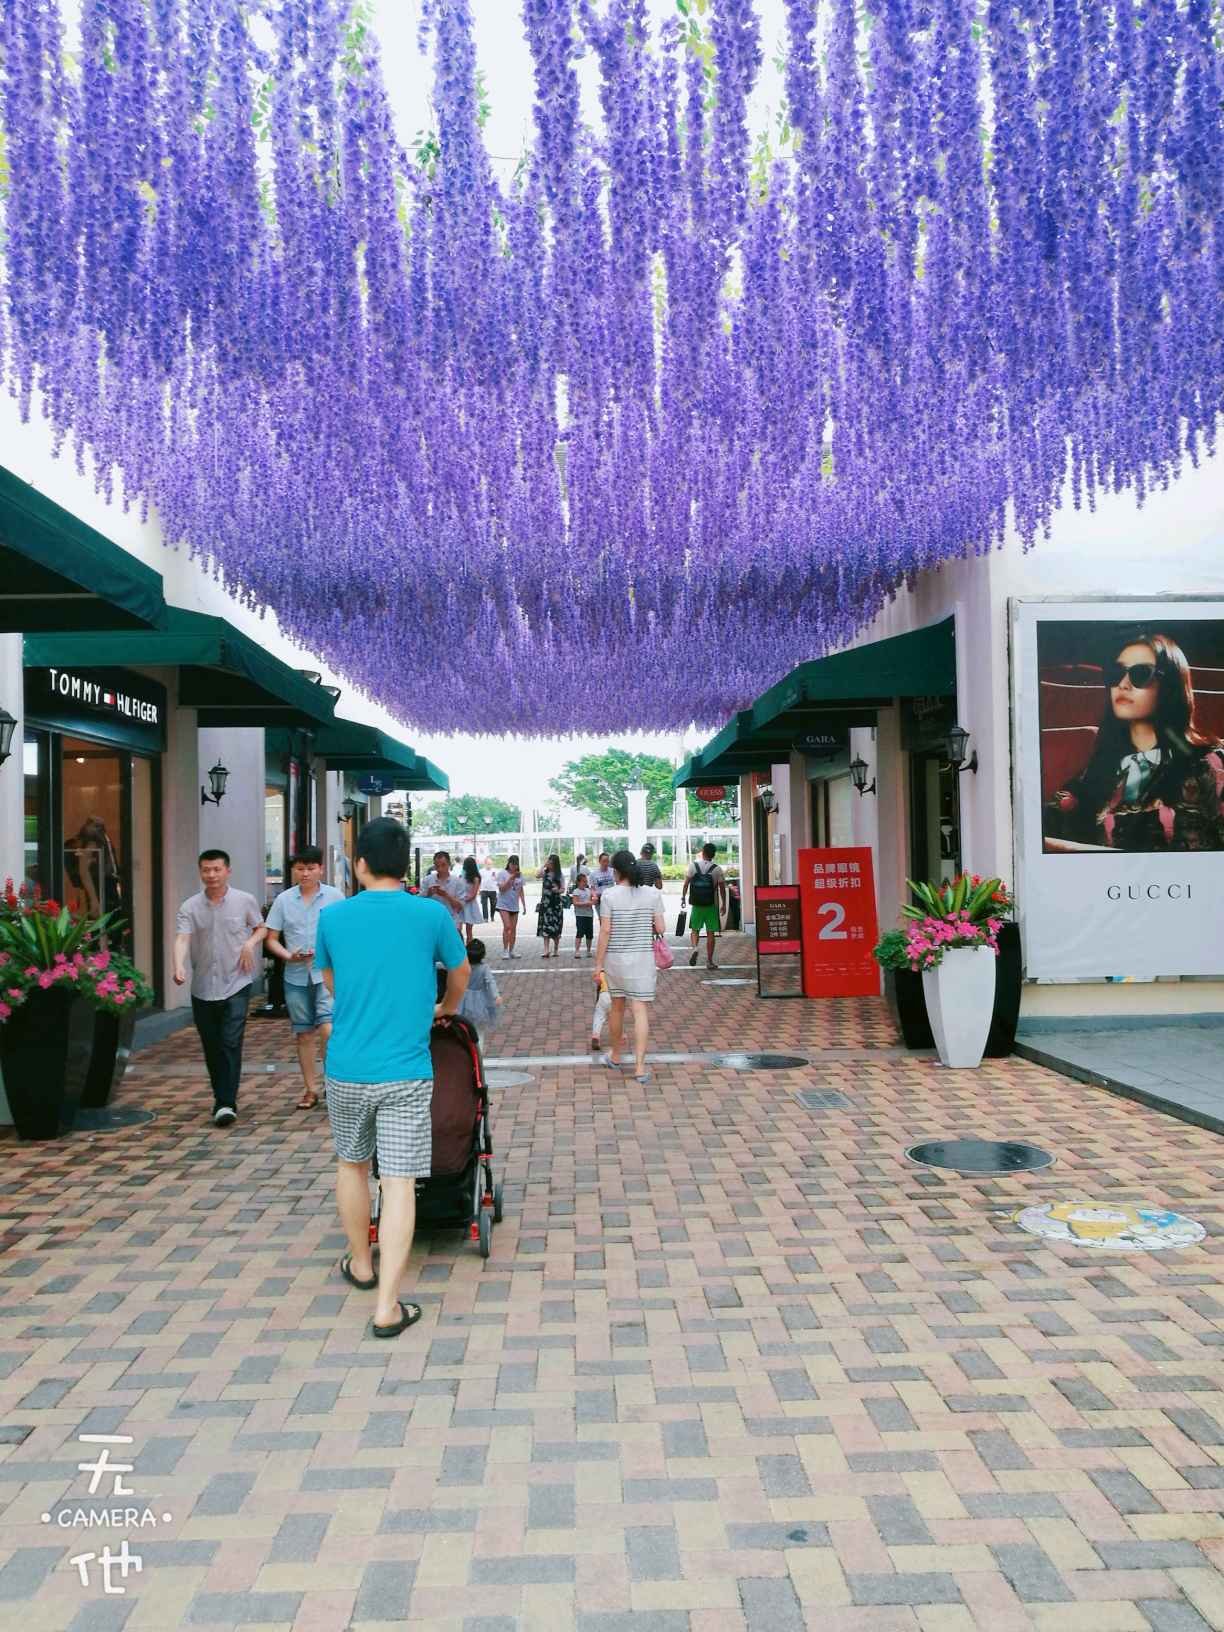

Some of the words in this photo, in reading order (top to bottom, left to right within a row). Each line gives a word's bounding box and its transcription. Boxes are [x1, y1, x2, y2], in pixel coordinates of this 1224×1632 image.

[49, 669, 101, 704] TOMMY
[116, 693, 158, 723] HILFIGER
[806, 735, 836, 743] GARA
[1107, 884, 1192, 900] GUCCI
[818, 902, 847, 939] 2
